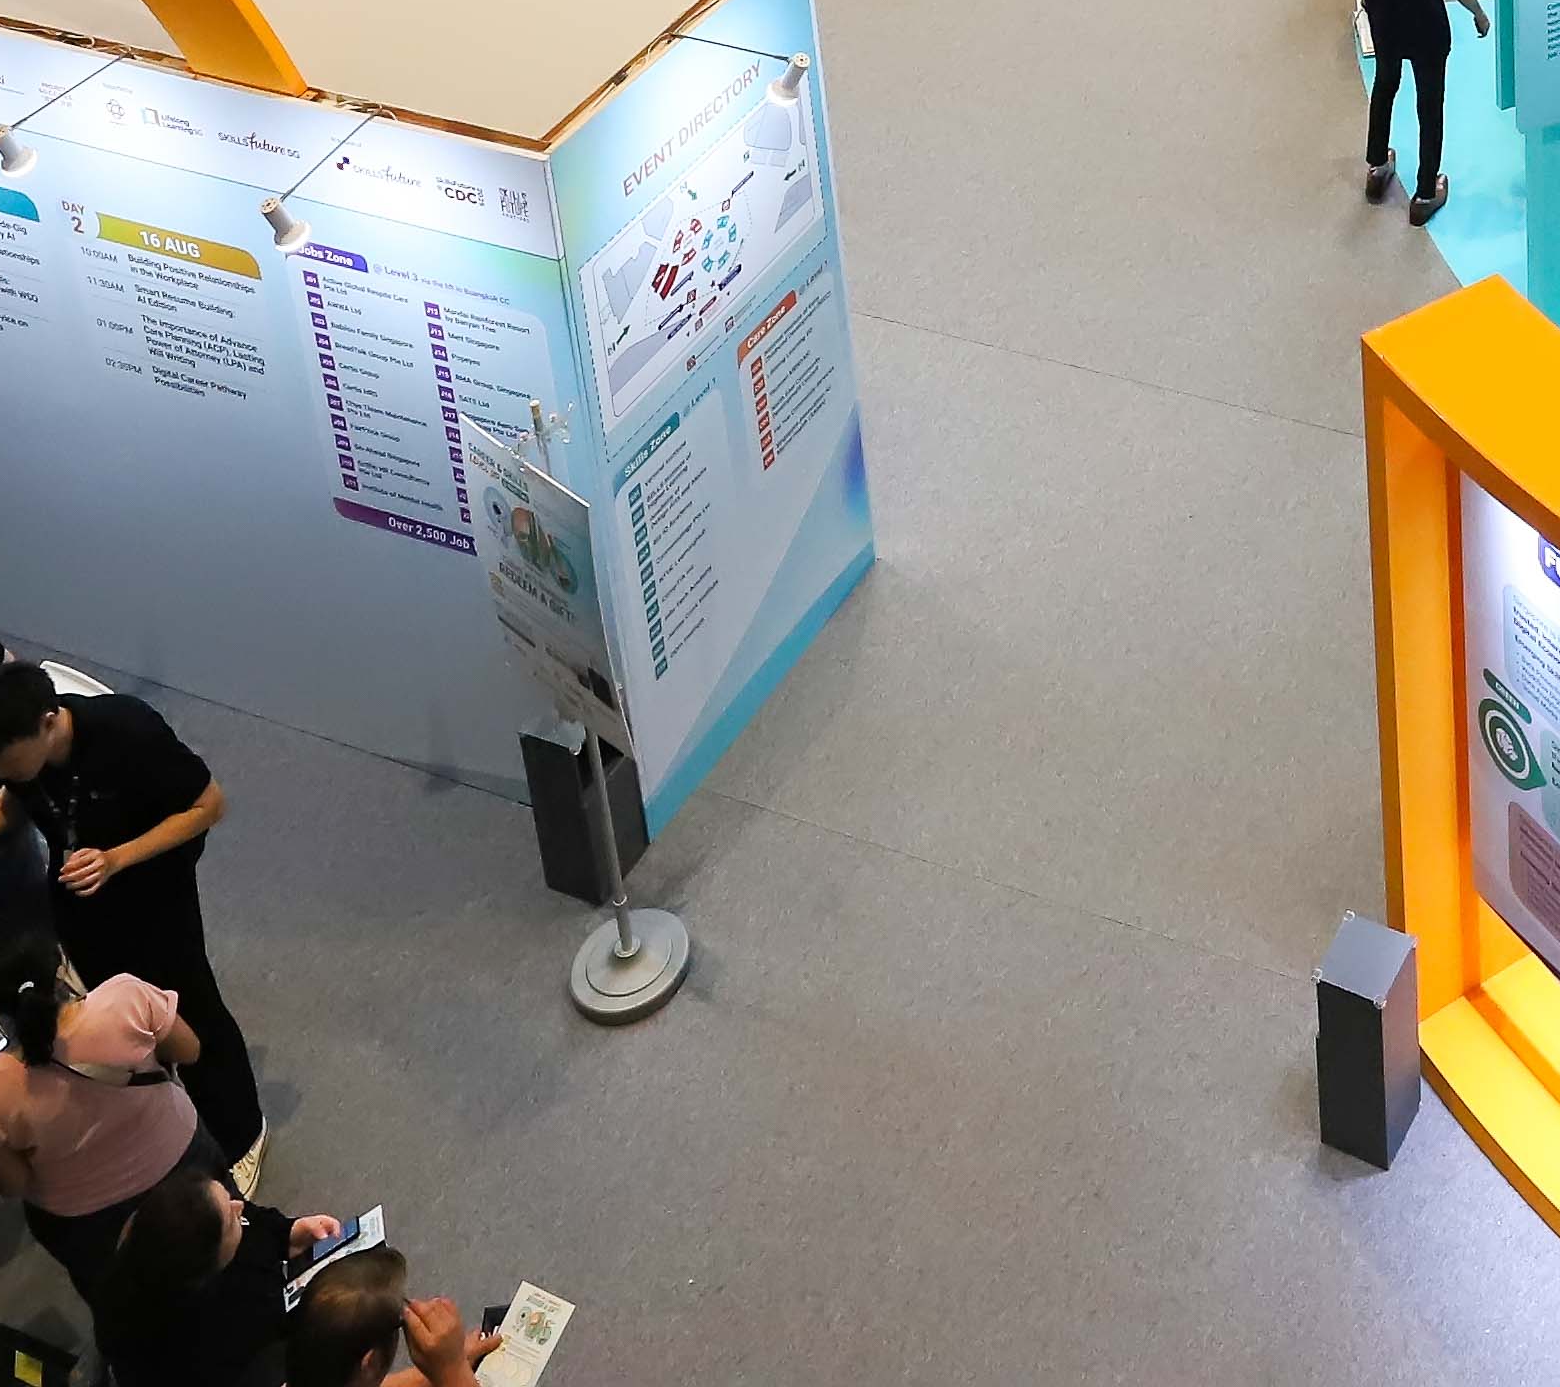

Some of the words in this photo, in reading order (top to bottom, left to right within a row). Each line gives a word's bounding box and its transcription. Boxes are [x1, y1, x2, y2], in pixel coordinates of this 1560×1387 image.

[140, 230, 161, 248] 16
[164, 236, 200, 258] AUG
[388, 515, 414, 532] Over
[416, 523, 446, 543] 2,500
[449, 534, 470, 549] Job
